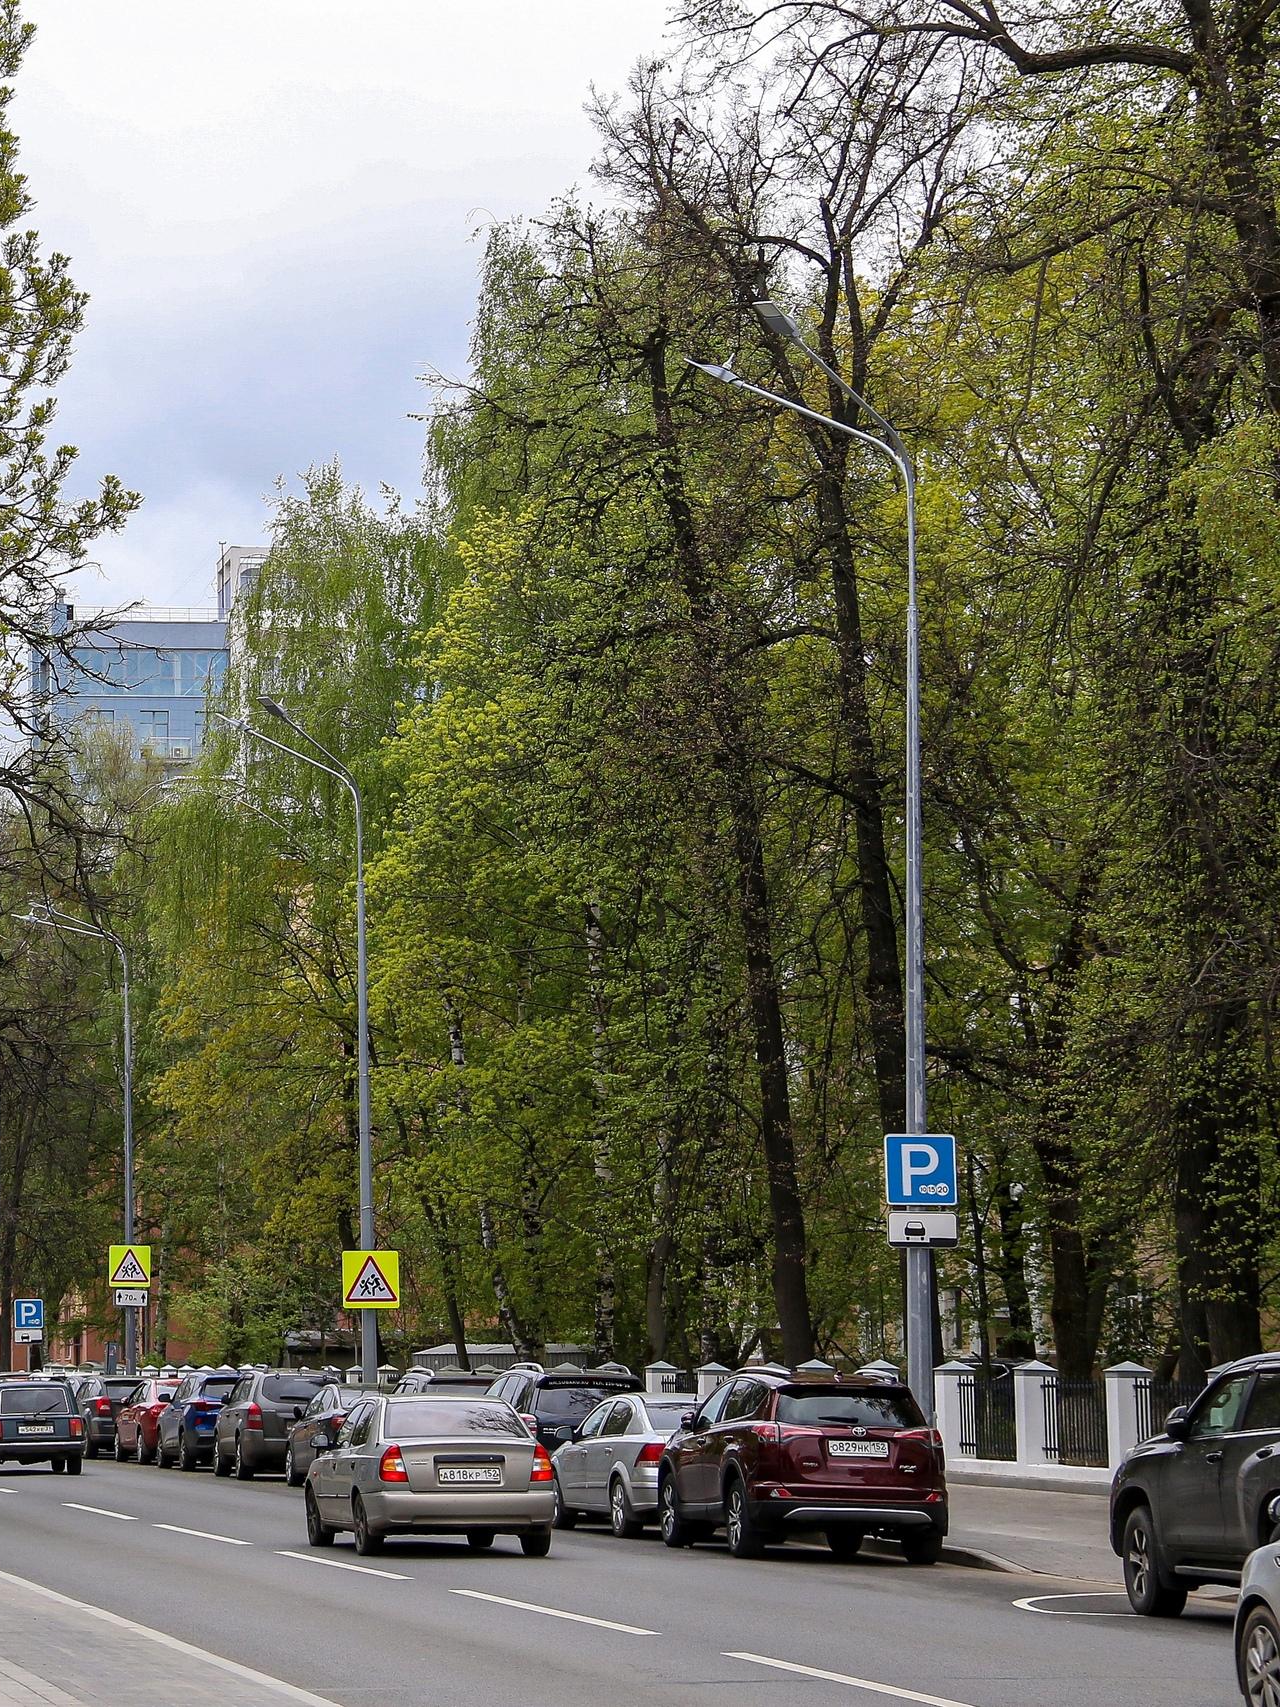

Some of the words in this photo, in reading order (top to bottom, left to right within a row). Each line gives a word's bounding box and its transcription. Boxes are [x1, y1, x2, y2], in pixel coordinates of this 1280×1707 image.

[901, 1143, 939, 1196] P
[21, 1303, 36, 1325] P
[871, 1442, 886, 1451] 152
[482, 1469, 498, 1478] 152
